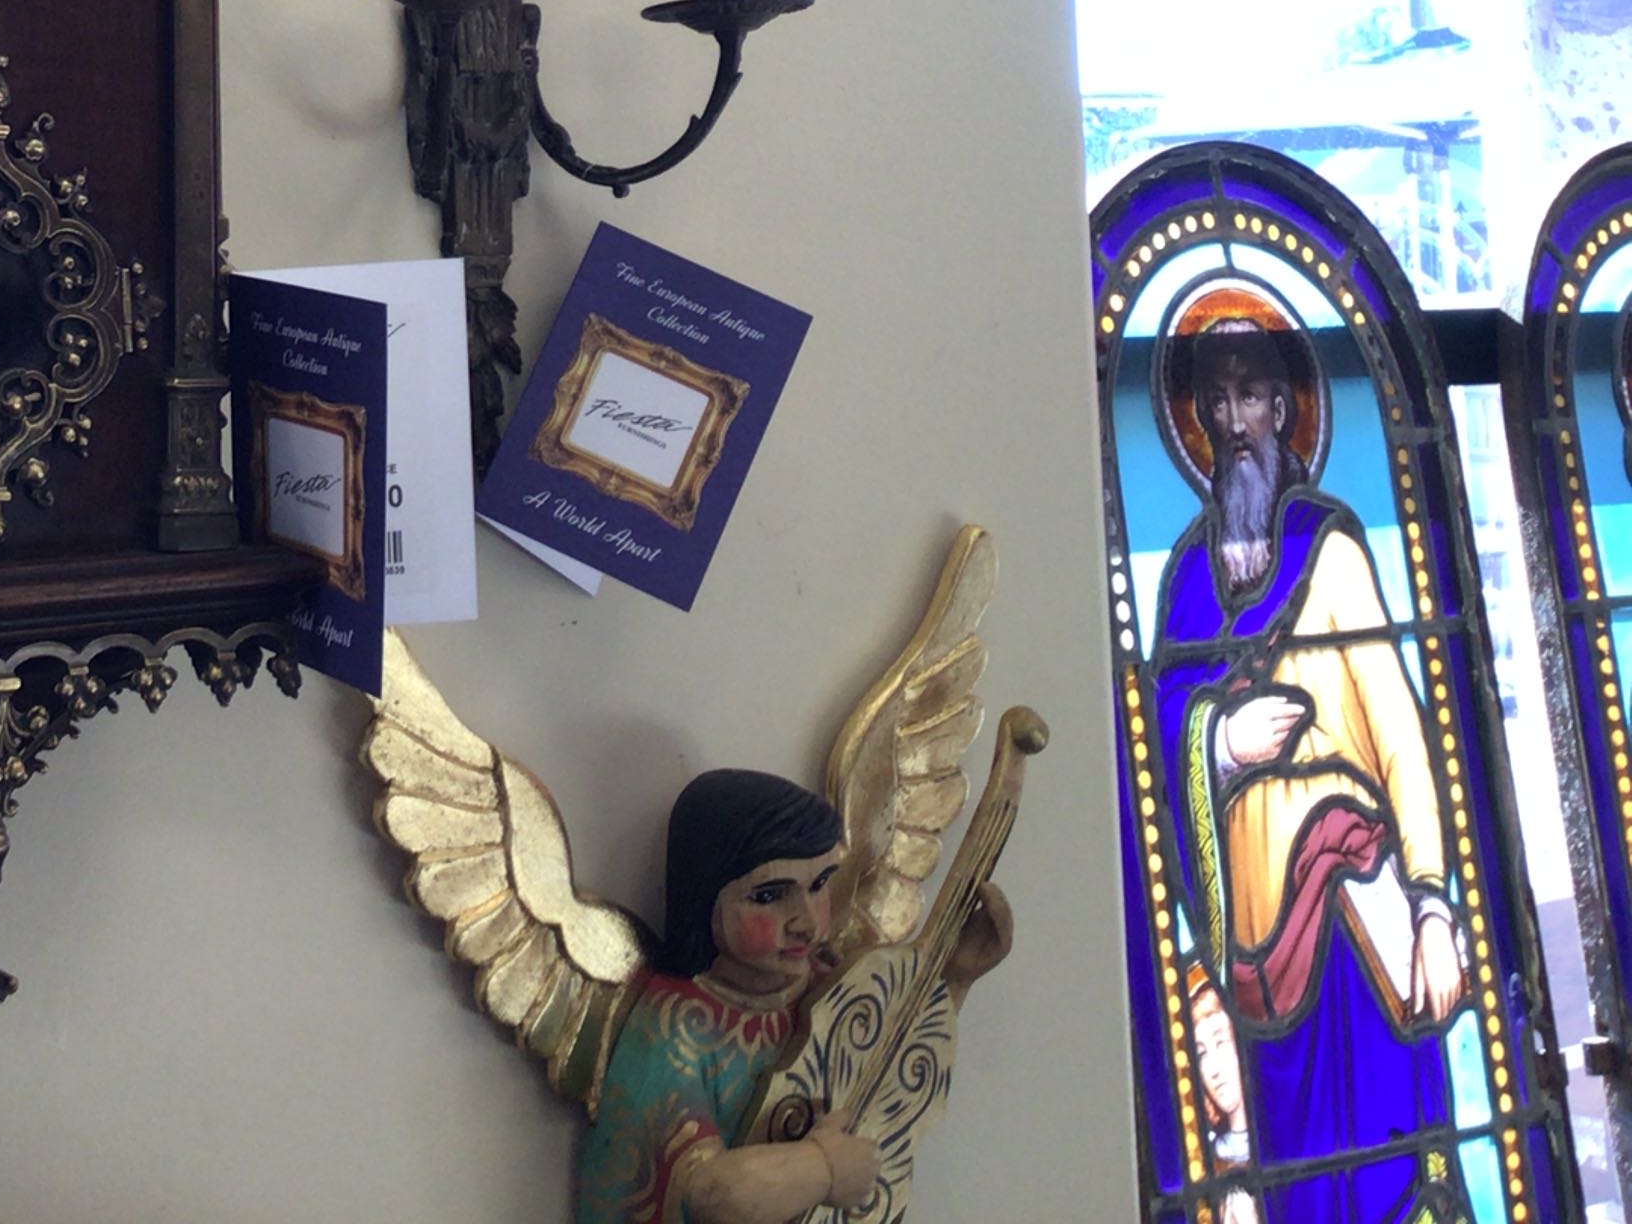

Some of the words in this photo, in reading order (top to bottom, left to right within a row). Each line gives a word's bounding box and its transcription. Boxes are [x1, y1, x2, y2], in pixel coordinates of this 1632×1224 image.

[617, 262, 646, 287] Fine
[647, 278, 708, 316] European
[708, 309, 765, 341] Antique
[274, 316, 319, 345] European
[320, 327, 362, 358] Antique
[647, 306, 710, 344] Collection
[282, 348, 328, 376] Collection
[584, 399, 693, 433] Fiesta
[273, 471, 342, 498] Fiesta
[522, 490, 552, 509] A
[553, 498, 607, 536] World
[602, 528, 662, 563] Apart
[314, 615, 354, 648] Apart
